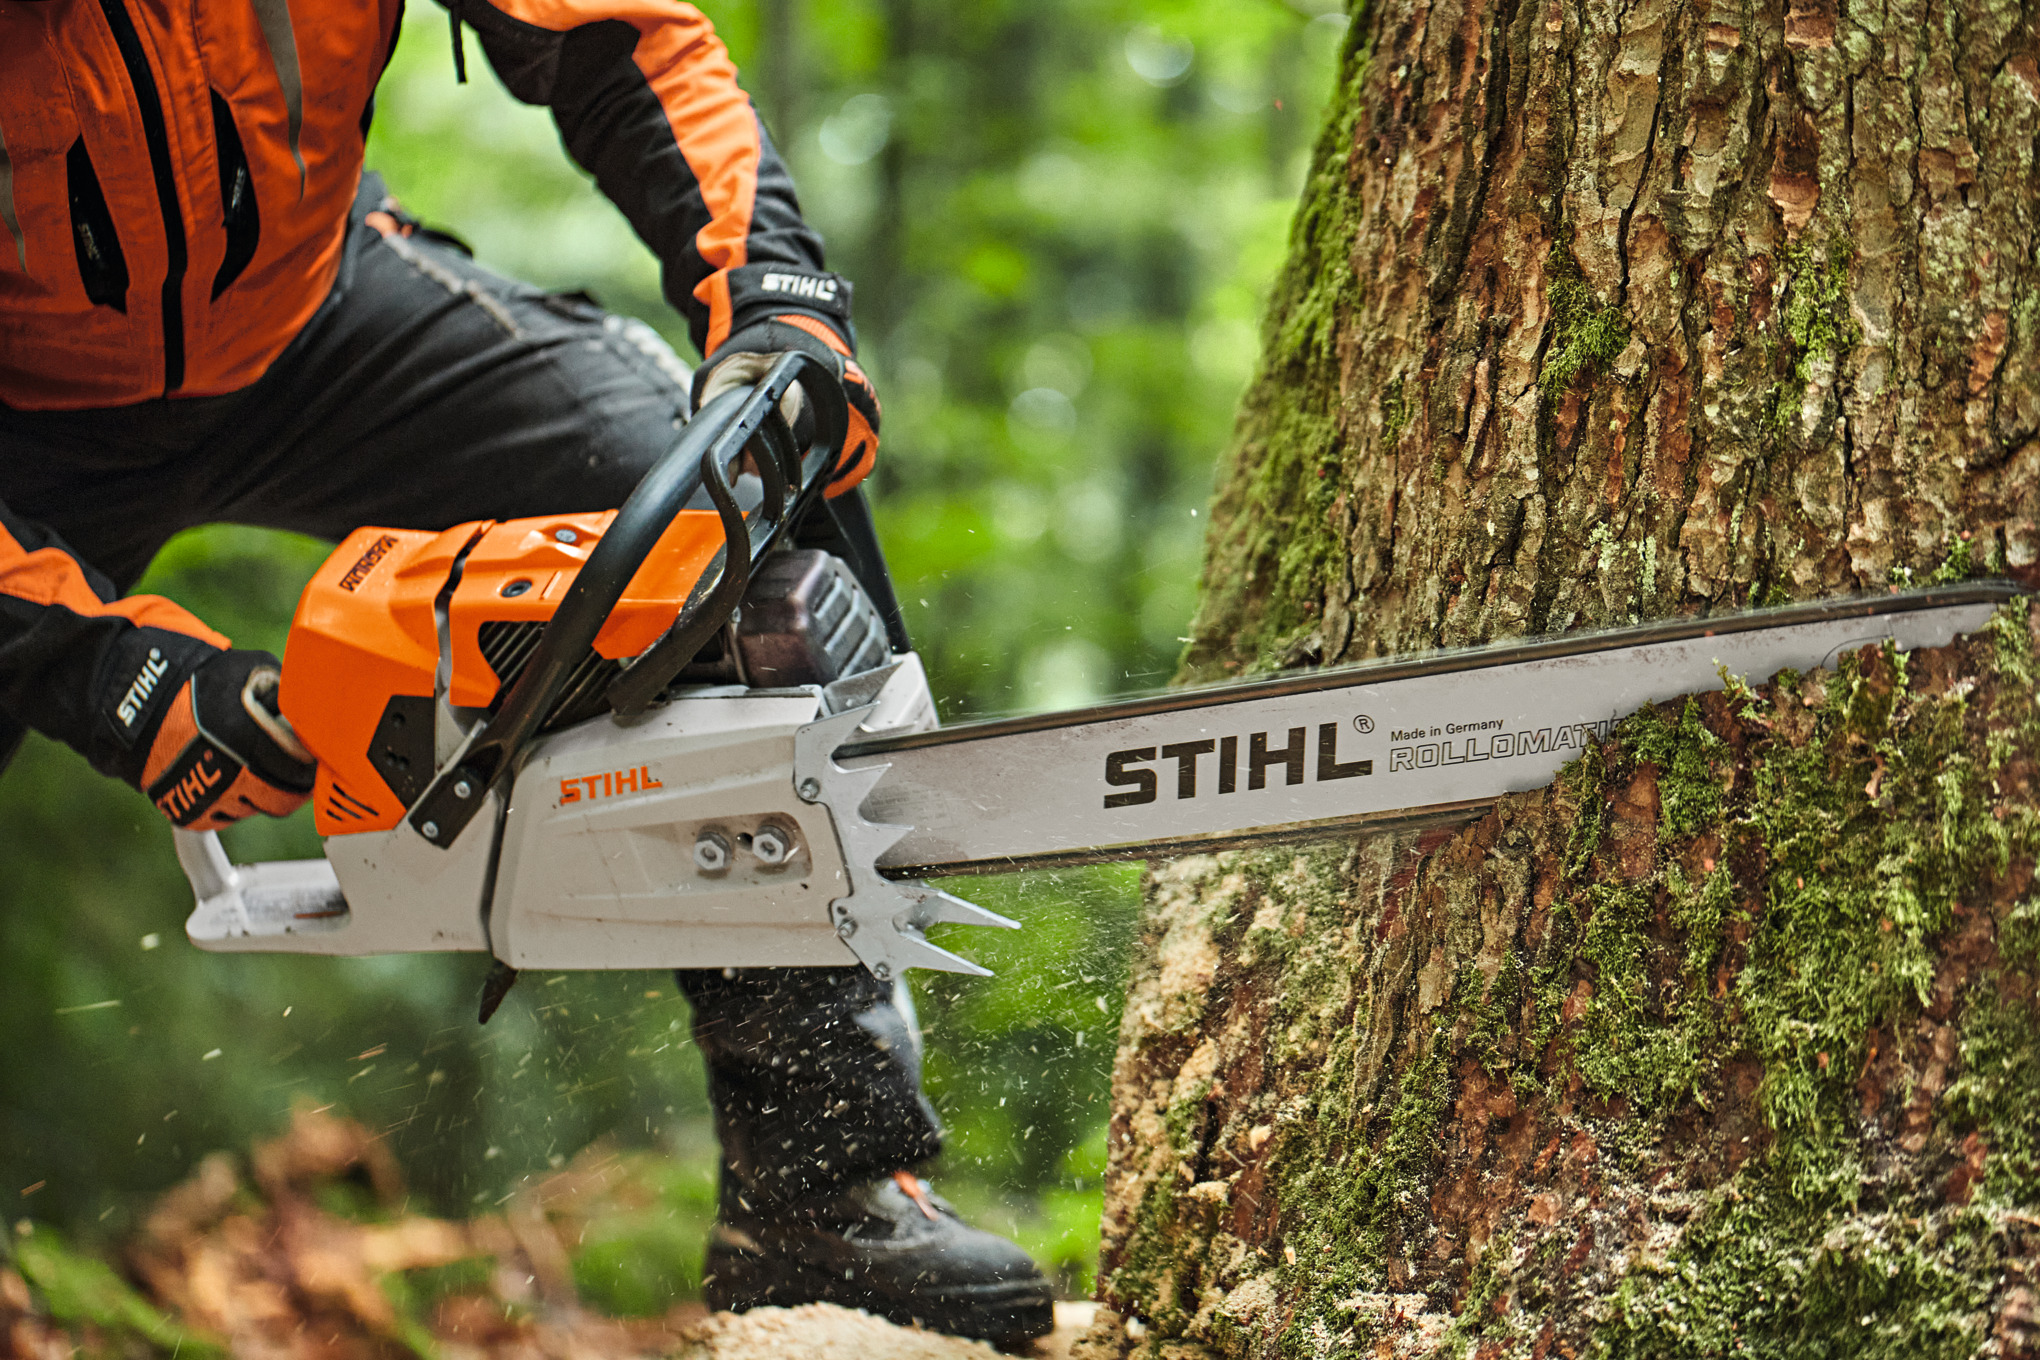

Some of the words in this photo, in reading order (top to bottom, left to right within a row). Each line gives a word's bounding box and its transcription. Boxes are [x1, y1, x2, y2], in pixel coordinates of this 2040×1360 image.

[761, 273, 836, 301] STIHL
[116, 658, 168, 728] STIHL
[1390, 729, 1426, 742] Made
[1430, 726, 1441, 737] in
[1446, 719, 1504, 735] Germany
[560, 766, 663, 805] STIHL
